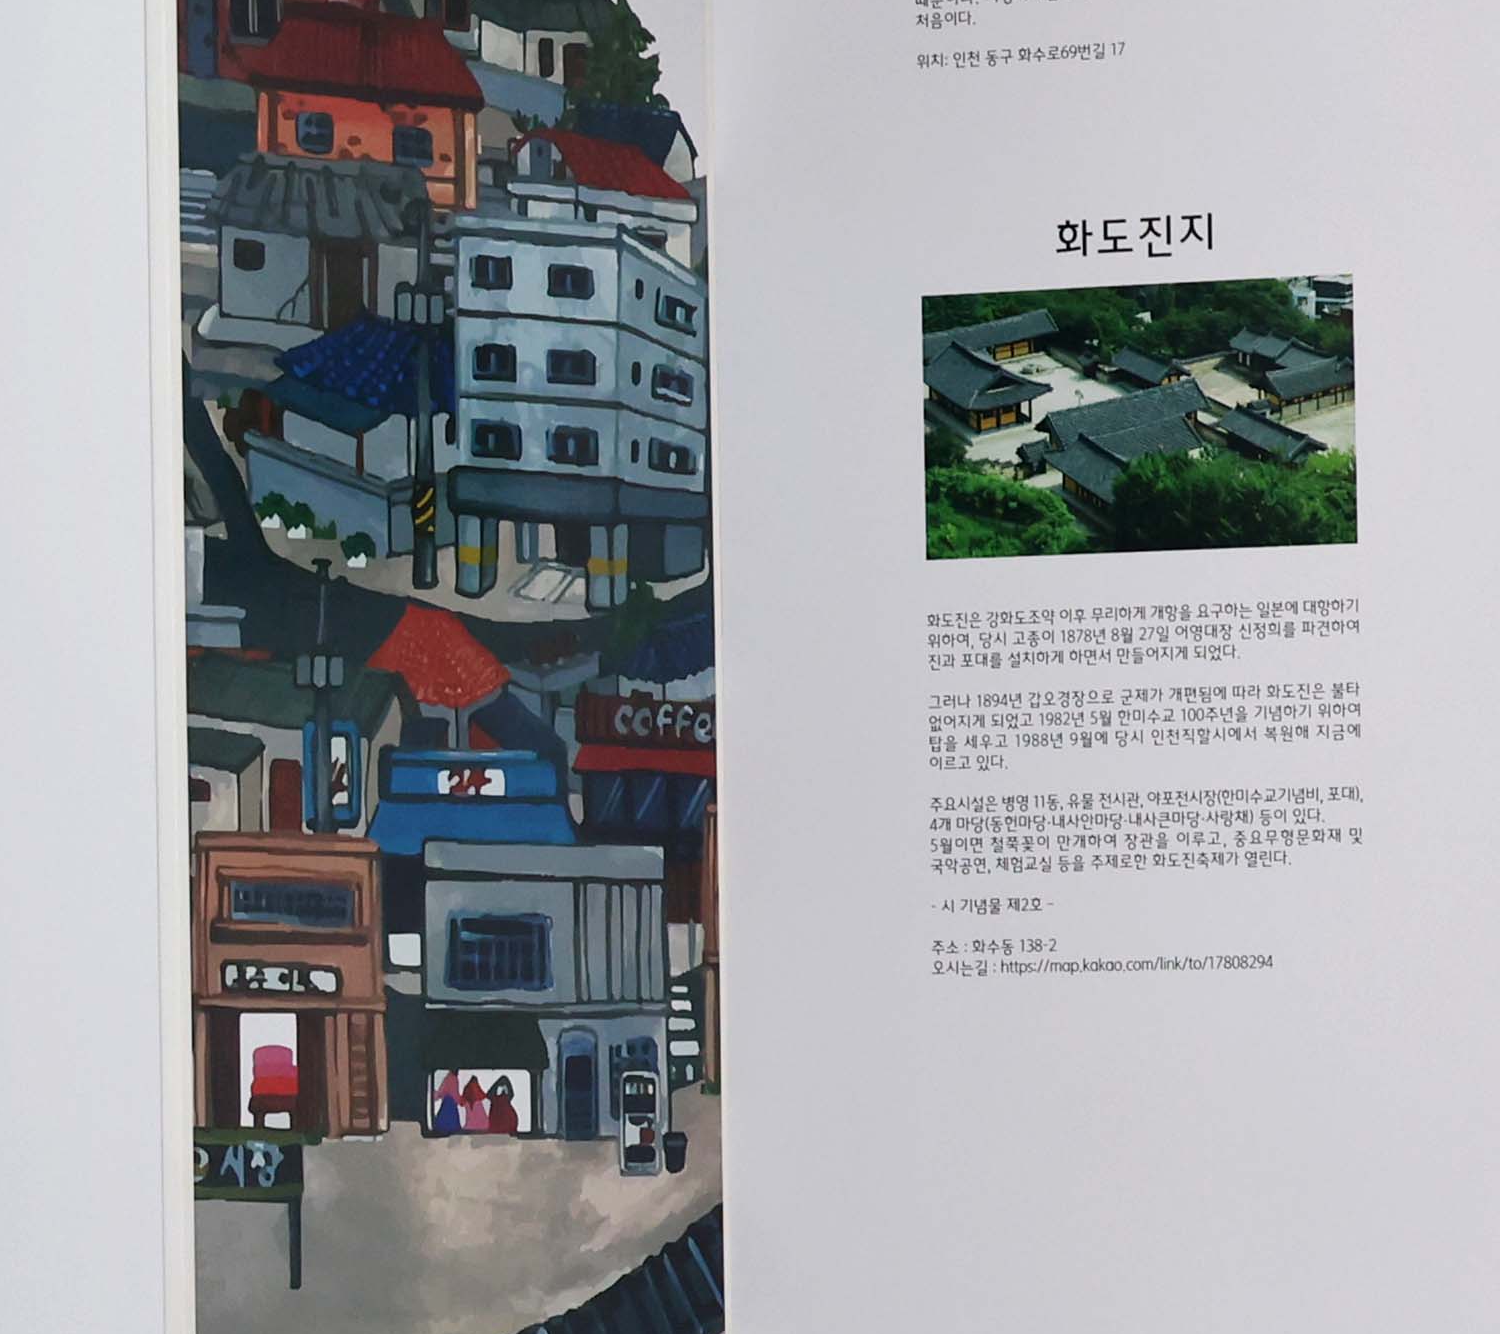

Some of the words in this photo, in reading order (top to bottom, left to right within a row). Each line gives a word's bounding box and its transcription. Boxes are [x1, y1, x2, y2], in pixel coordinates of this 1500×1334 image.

[916, 52, 948, 70] 위치:
[953, 50, 980, 69] 인천
[985, 48, 1014, 68] 동구
[1018, 42, 1105, 63] 화수로69번길
[1111, 41, 1125, 56] 17
[1055, 212, 1213, 258] 화도진지
[927, 611, 983, 630] 화도진은
[985, 608, 1055, 629] 강화도조약
[1059, 607, 1087, 624] 이후
[1090, 605, 1146, 624] 무리하게
[1150, 603, 1193, 623] 개항을
[1196, 602, 1252, 620] 요구하는
[1256, 600, 1298, 619] 일본에
[1303, 597, 1359, 618] 대항하기
[929, 713, 985, 733] 없어지게
[989, 712, 1034, 731] 되었고
[1038, 710, 1084, 728] 1982년
[1090, 708, 1112, 728] 5월
[1118, 707, 1176, 727] 한미수교
[1181, 704, 1251, 724] 100주년을
[1254, 703, 1311, 722] 기념하기
[1318, 702, 1361, 719] 위하여
[932, 939, 959, 955] 주소
[972, 938, 1014, 957] 화수동
[1020, 937, 1057, 954] 138-2
[932, 959, 988, 978] 오시는길
